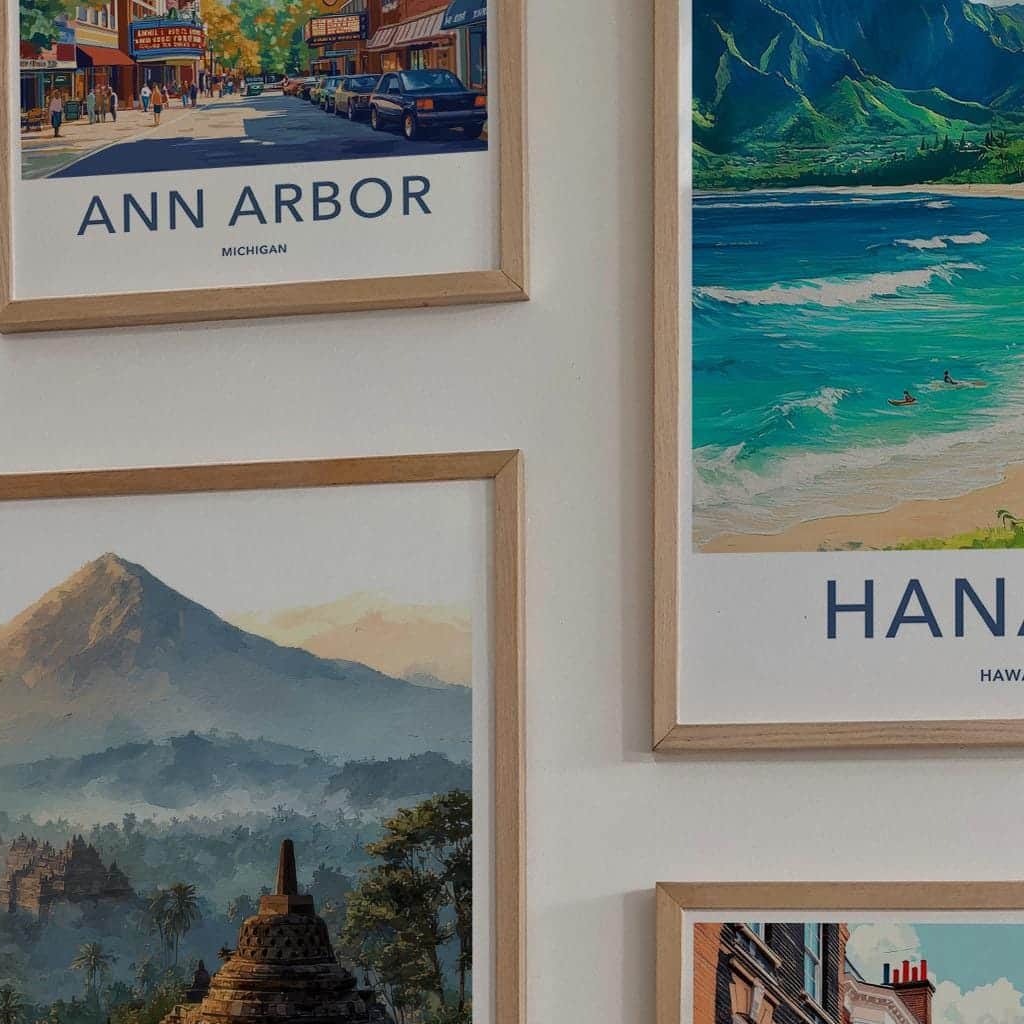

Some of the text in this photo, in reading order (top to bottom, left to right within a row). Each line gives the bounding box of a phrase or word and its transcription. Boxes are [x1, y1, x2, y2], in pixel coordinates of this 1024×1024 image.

[77, 174, 433, 236] ANN ARBOR
[221, 243, 288, 257] MICHIGAN
[826, 577, 1024, 639] HAN
[980, 668, 1024, 682] HAW
